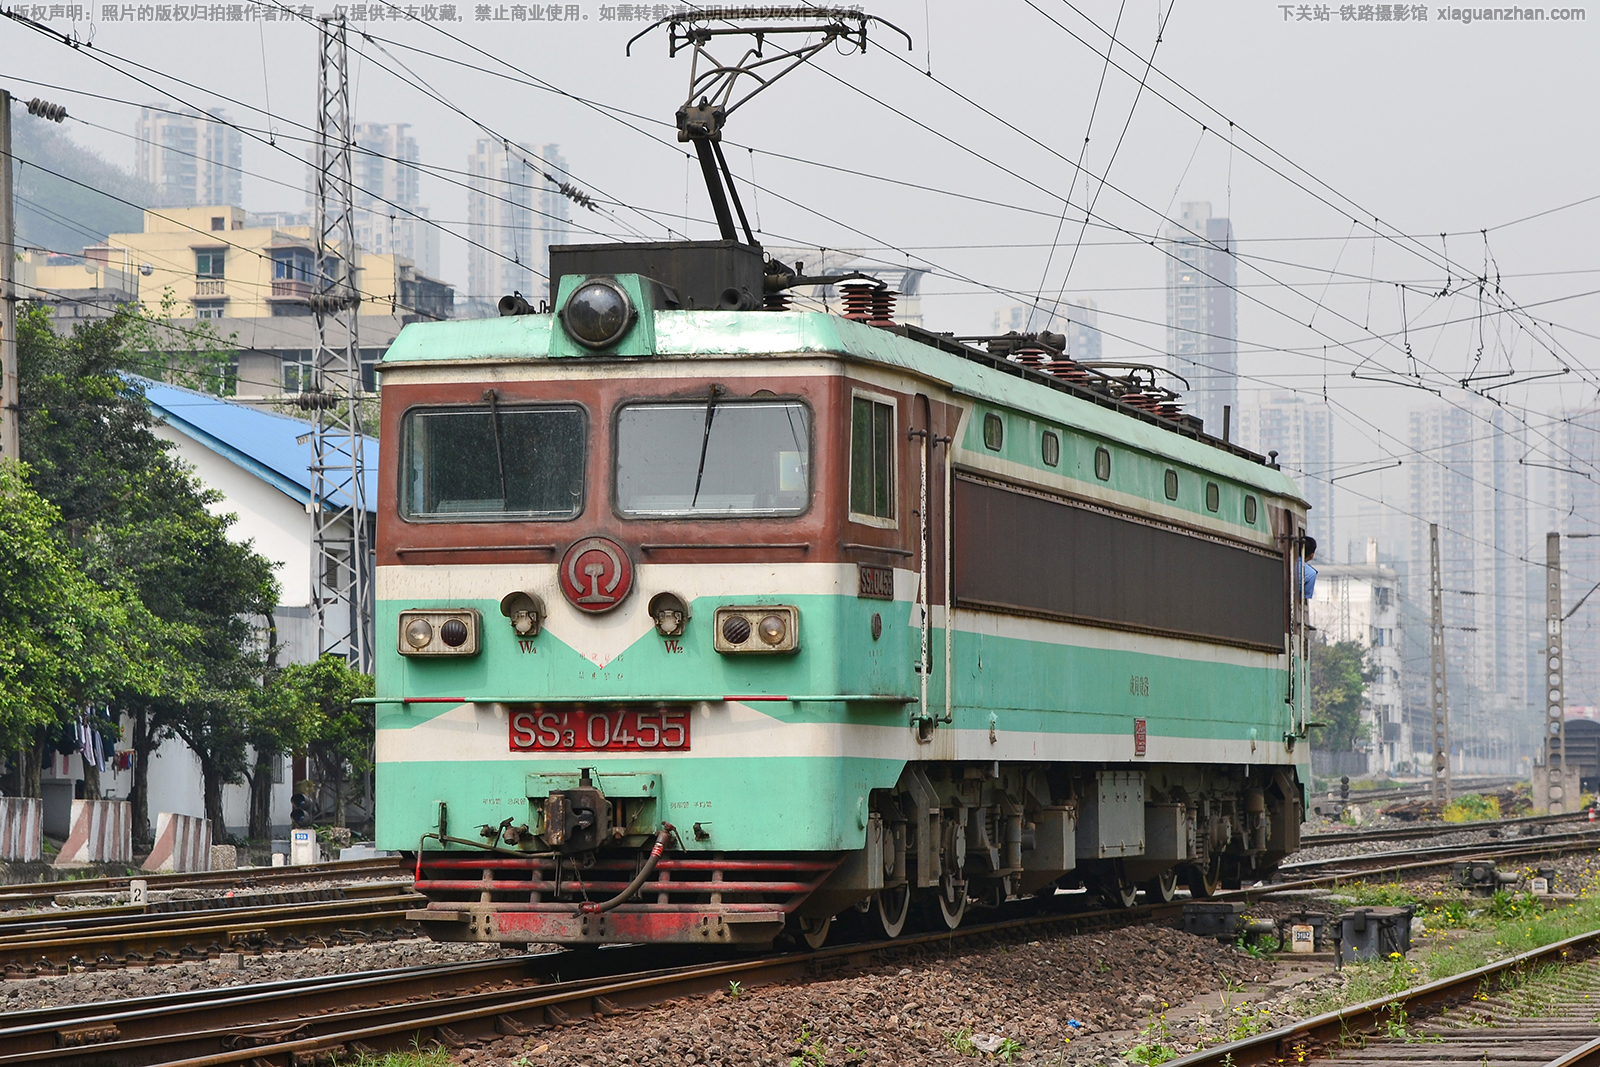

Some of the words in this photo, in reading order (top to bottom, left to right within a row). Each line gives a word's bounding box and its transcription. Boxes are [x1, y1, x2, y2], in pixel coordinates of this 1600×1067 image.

[664, 640, 684, 654] W2
[587, 713, 685, 748] 0455
[134, 888, 142, 902] 2
